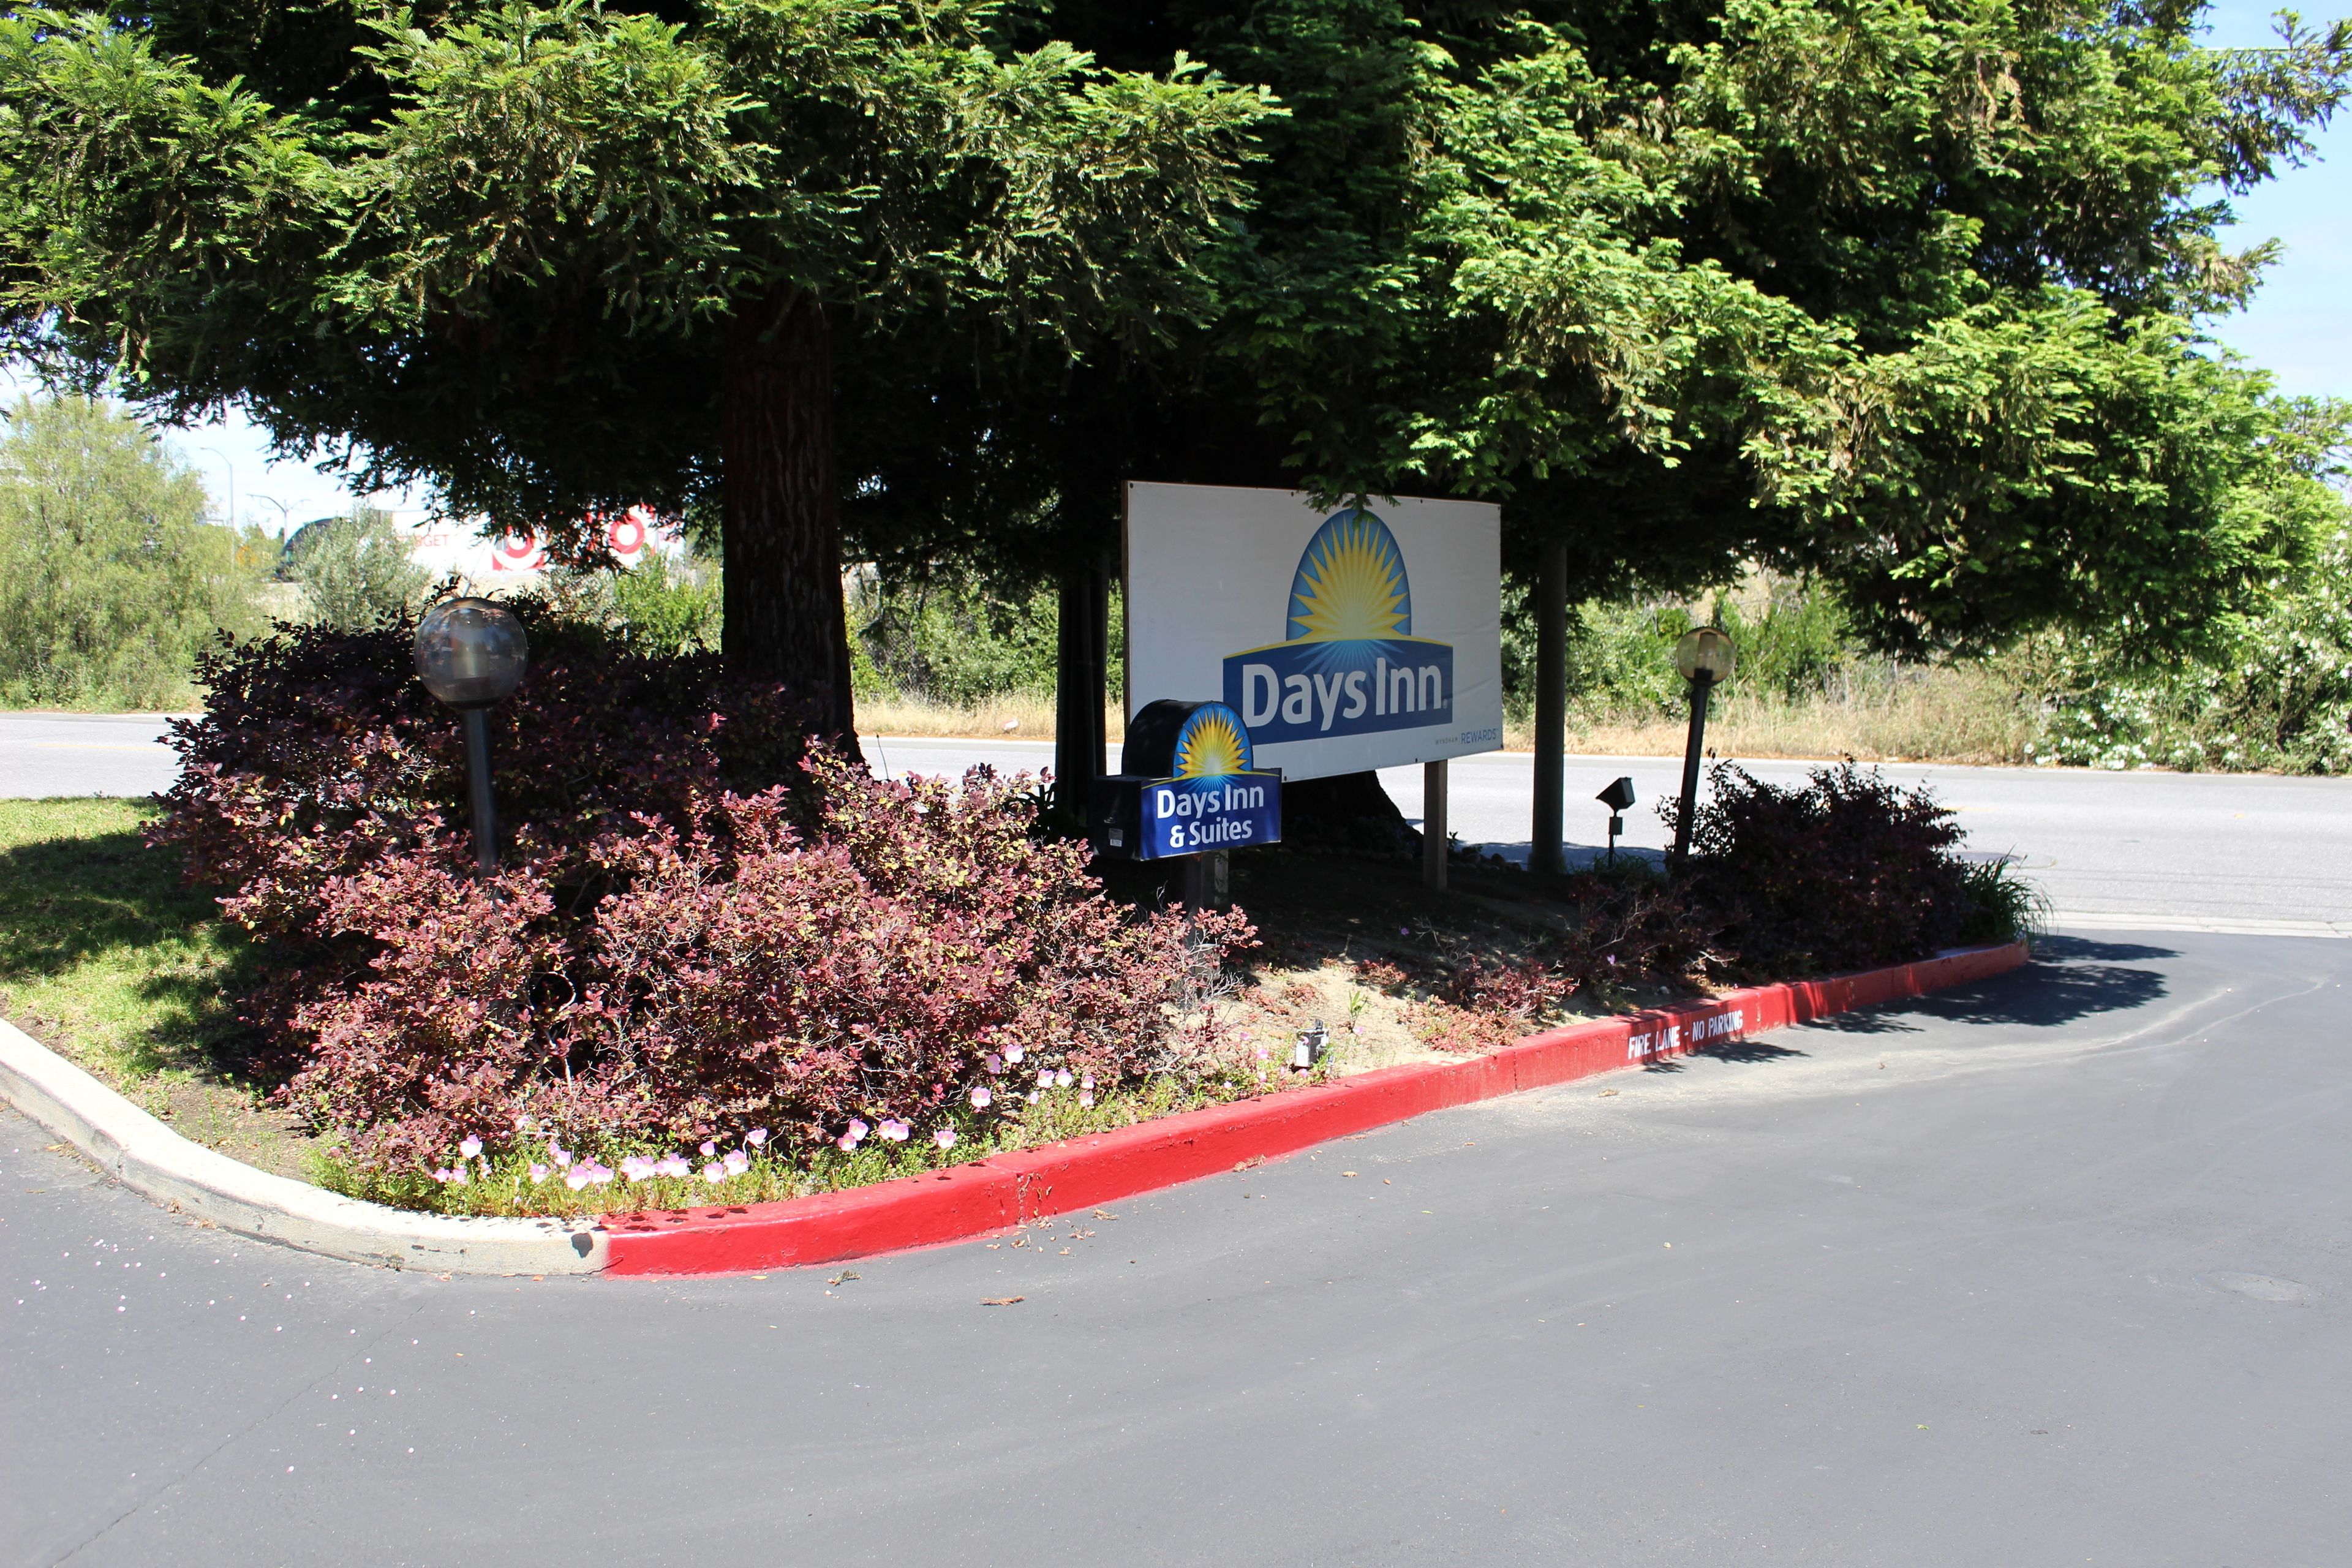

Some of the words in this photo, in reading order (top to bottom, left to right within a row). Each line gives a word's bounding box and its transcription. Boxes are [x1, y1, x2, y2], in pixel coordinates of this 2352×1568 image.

[1243, 663, 1367, 731] Days
[1376, 657, 1442, 715] Inn
[1461, 728, 1497, 744] REWARDS
[1157, 790, 1220, 819] Days
[1225, 784, 1264, 811] Inn
[1169, 825, 1185, 848] &
[1189, 816, 1253, 845] Suites
[1628, 1033, 1651, 1060] FIRE
[1655, 1025, 1680, 1052] LANE
[1692, 1020, 1705, 1042] NO
[1708, 1010, 1743, 1038] PARKING
